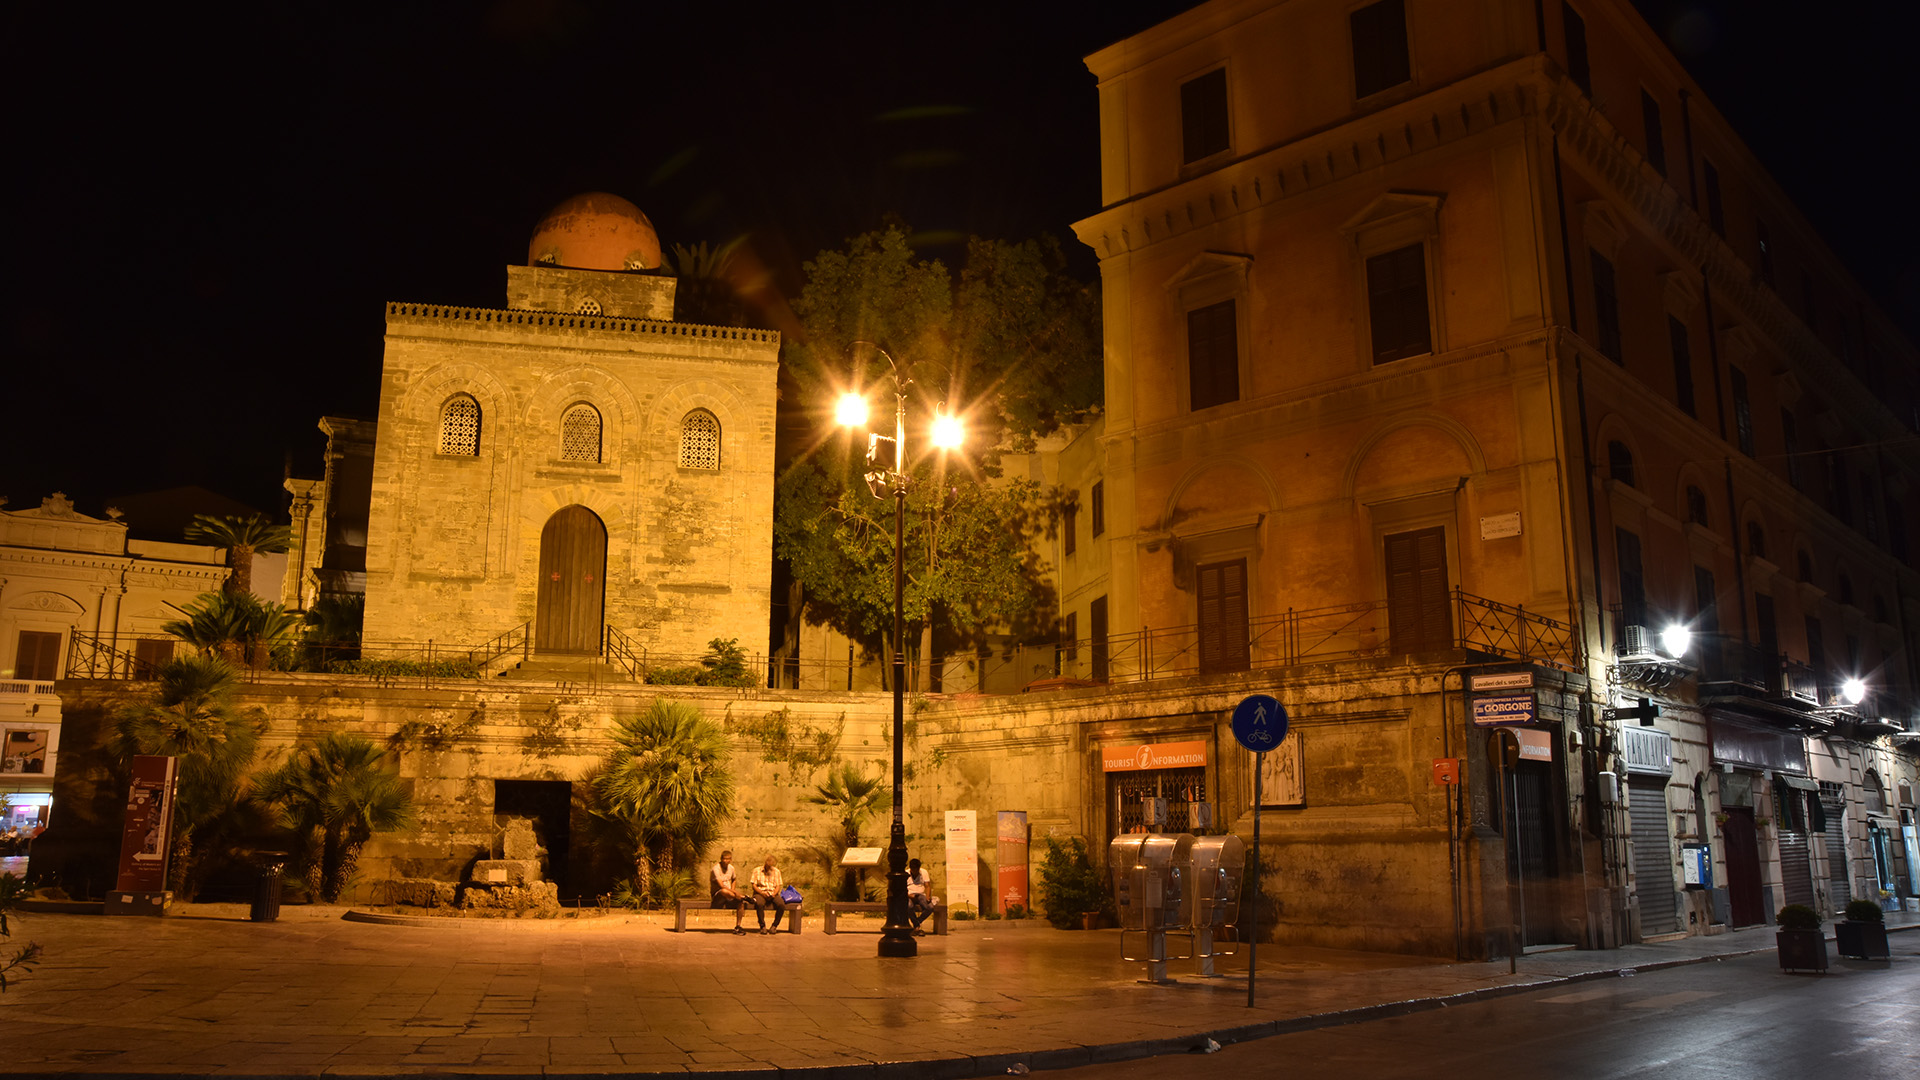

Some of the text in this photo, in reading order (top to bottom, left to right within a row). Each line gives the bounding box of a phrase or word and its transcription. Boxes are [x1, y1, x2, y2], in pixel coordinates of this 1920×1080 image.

[1484, 702, 1532, 713] GORGONE
[1626, 731, 1669, 767] FARMACIA
[1104, 758, 1135, 769] TOURIST
